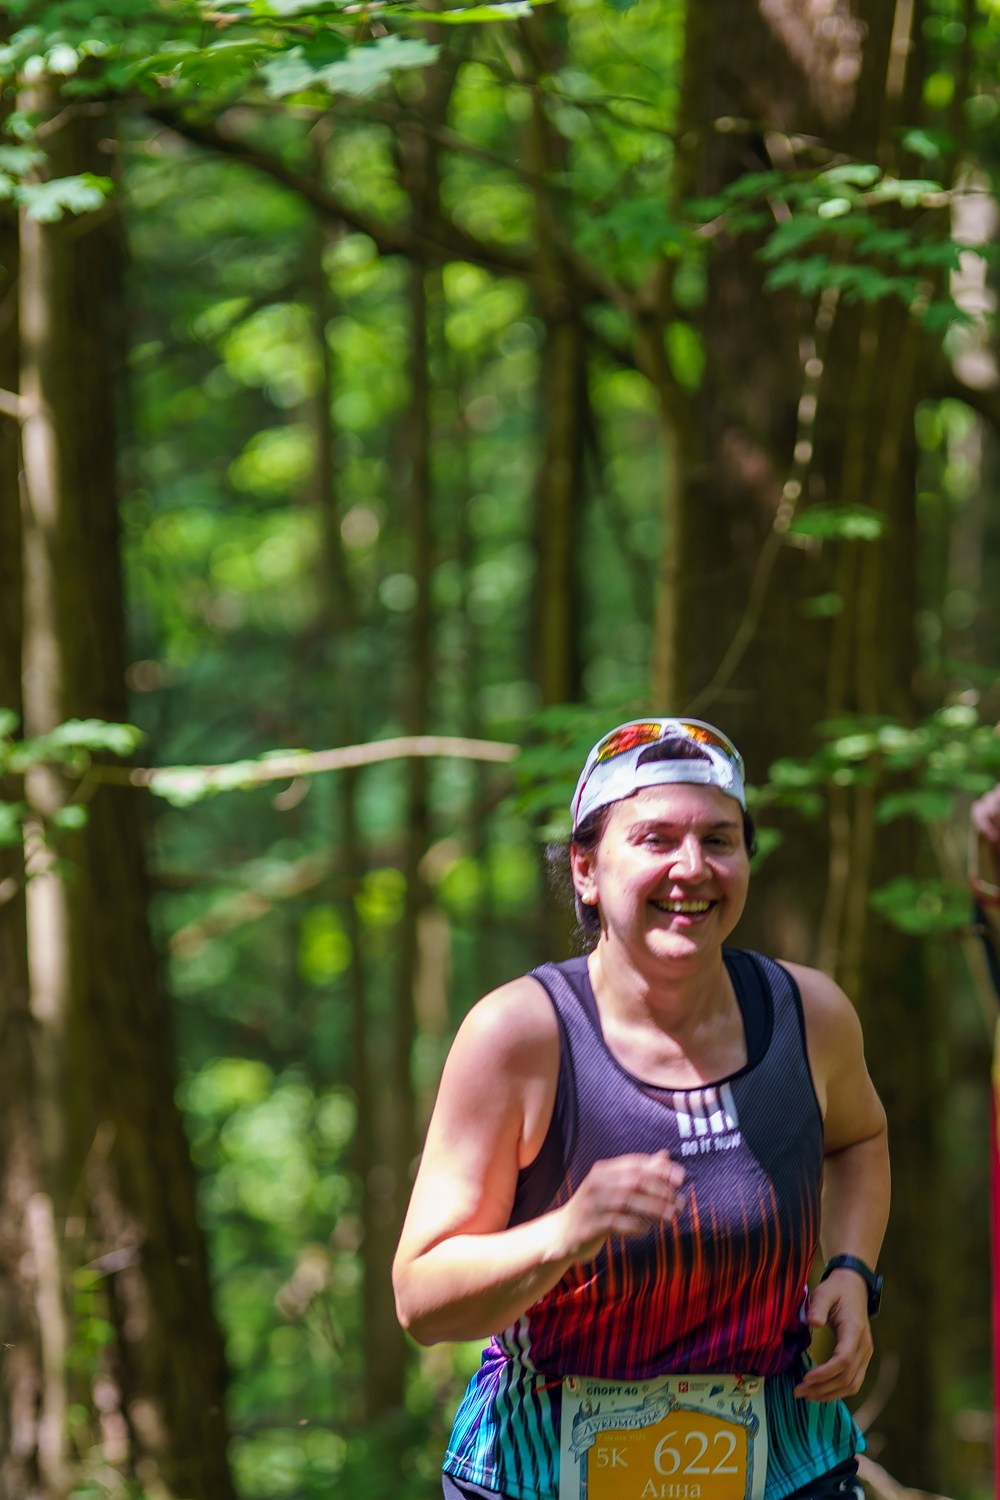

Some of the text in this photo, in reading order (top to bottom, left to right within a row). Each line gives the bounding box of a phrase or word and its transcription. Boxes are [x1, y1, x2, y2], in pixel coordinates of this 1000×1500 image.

[586, 1386, 638, 1396] СПОРТ 40
[653, 1430, 738, 1475] 622
[641, 1478, 701, 1498] Анна
